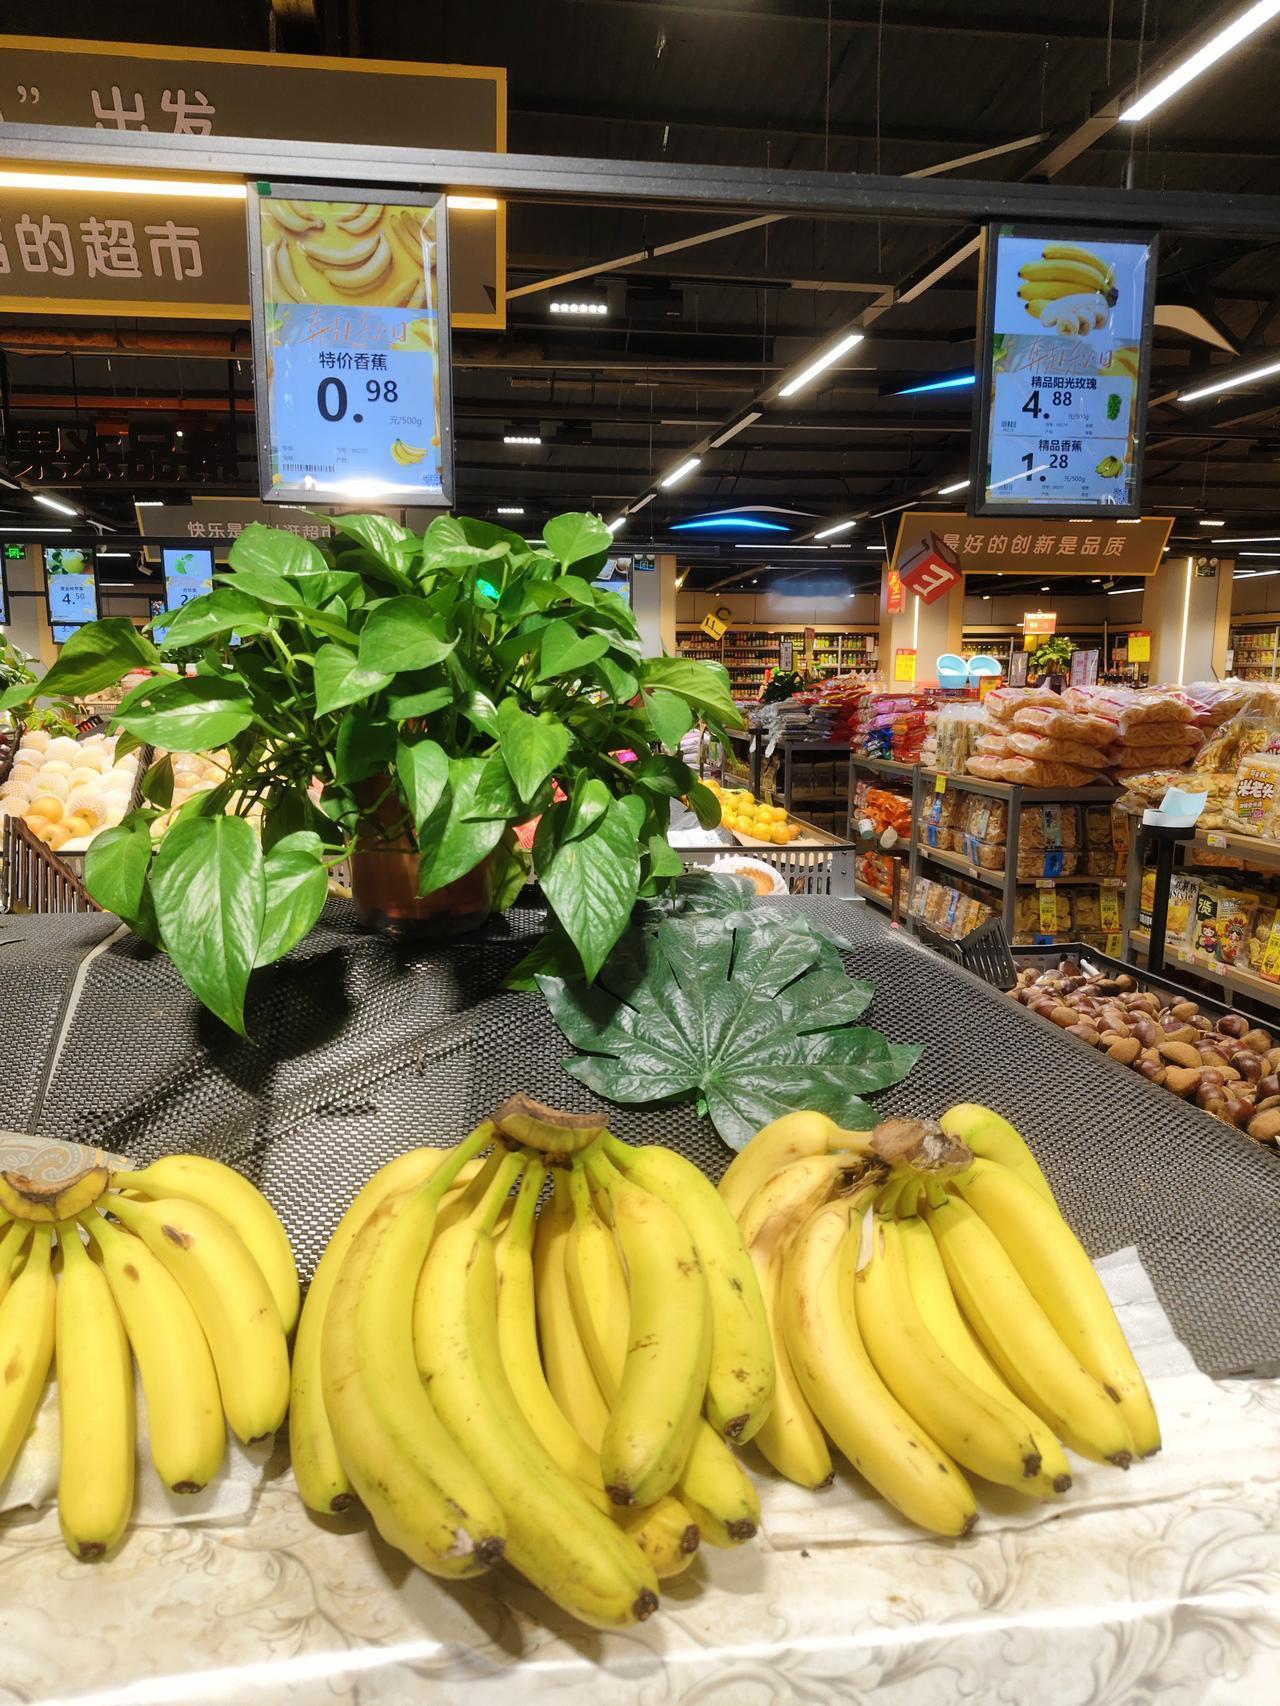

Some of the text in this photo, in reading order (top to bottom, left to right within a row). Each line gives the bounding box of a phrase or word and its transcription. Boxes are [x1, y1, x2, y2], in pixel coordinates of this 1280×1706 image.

[0, 214, 203, 281] 的超市
[319, 351, 388, 371] 特价香蕉
[1031, 376, 1097, 390] 精品阳光玫瑰
[317, 377, 399, 424] 0.98
[1022, 390, 1072, 420] 4.88
[390, 416, 422, 427] 元/500g
[1039, 439, 1082, 453] 精品香蕉
[1021, 452, 1069, 482] 1.28
[942, 532, 1127, 557] 最好的创新是品质
[1237, 779, 1275, 799] 米老头
